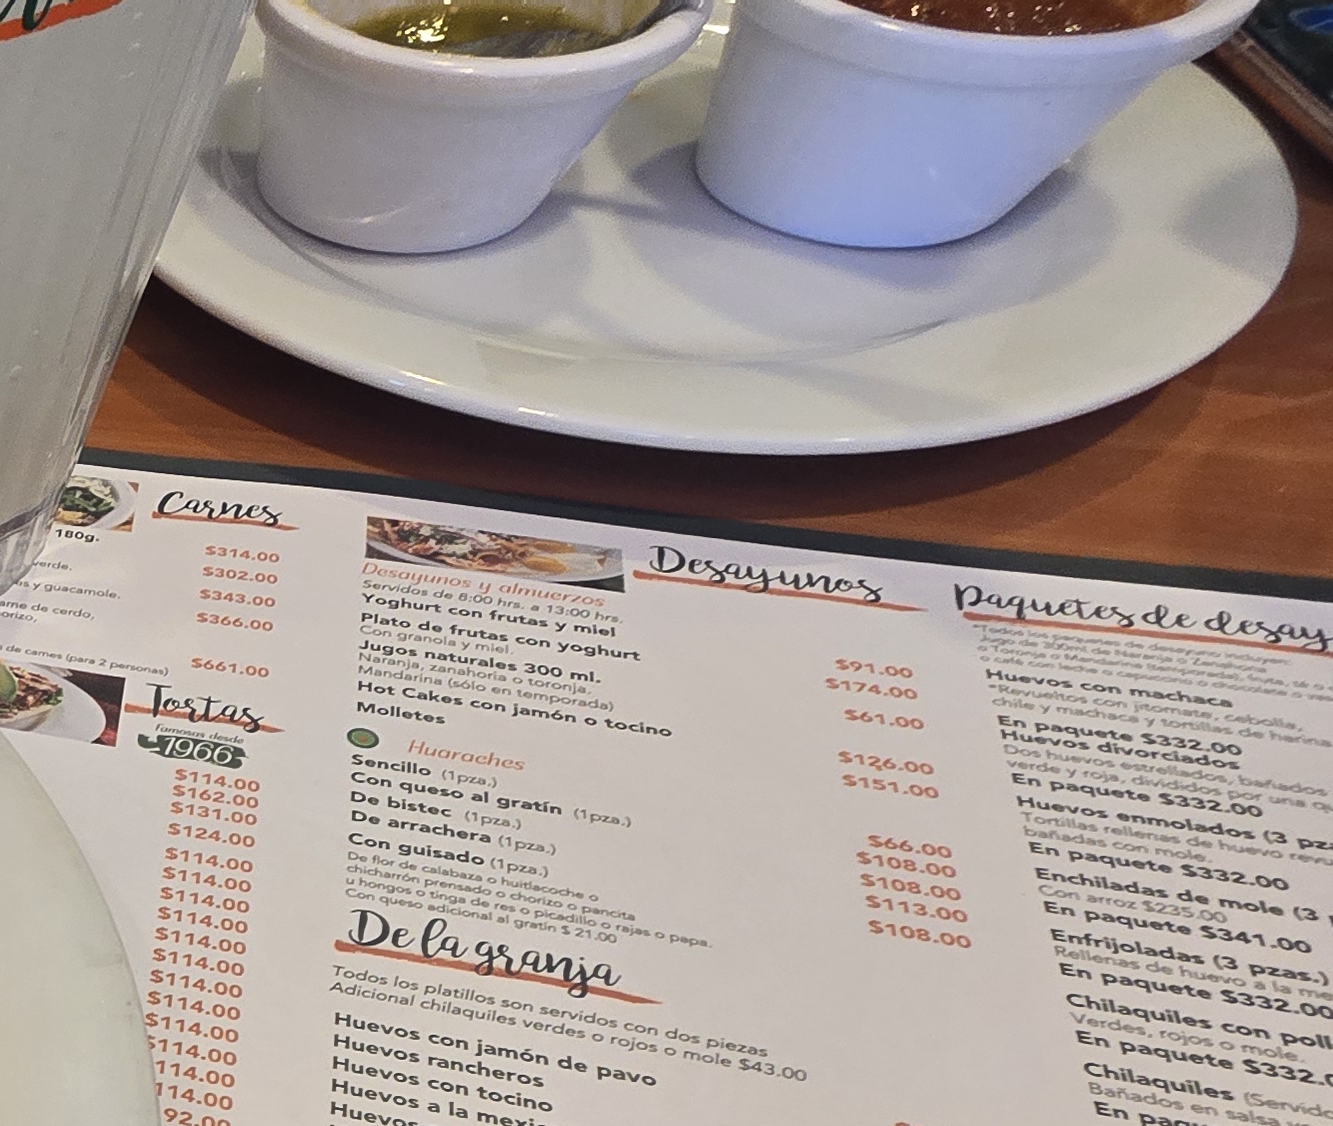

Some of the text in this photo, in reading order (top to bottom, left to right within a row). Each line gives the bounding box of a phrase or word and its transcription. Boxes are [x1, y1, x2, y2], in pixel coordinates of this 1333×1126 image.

[157, 490, 283, 527] Carnes
[203, 544, 281, 564] $314.00
[201, 564, 279, 585] $302.00
[648, 544, 884, 604] Desayunos
[198, 587, 276, 608] $343.00
[953, 583, 1137, 628] Paquetes
[1141, 604, 1198, 630] de
[195, 610, 274, 633] $366.00
[360, 591, 617, 639] Yoghurt con frutas y miel
[190, 656, 270, 679] $661.00
[833, 657, 914, 679] $91.00
[357, 663, 615, 713] Mandarina (sólo en temporada)
[823, 676, 919, 701] $174.00
[984, 667, 1235, 709] Huevos con machaca
[145, 682, 265, 734] Tortas
[355, 700, 446, 725] Molletes
[356, 679, 673, 738] Hot Cakes con jamón o tocino
[842, 707, 925, 731] $61.00
[162, 736, 234, 765] 1966
[407, 738, 526, 771] Huaraches
[836, 749, 935, 776] $126.00
[173, 767, 261, 793] $114.00
[840, 772, 940, 800] $151.00
[171, 783, 260, 810] $162.00
[168, 799, 258, 827] $131.00
[166, 821, 256, 849] $124.00
[350, 808, 557, 857] De arrachera (1pza.)
[866, 833, 953, 859] $66.00
[164, 846, 253, 874] $114.00
[854, 849, 958, 879] $108.00
[864, 893, 969, 924] $113.00
[154, 927, 247, 956] $114.00
[1042, 899, 1313, 955] En paquete $341.00
[347, 908, 622, 999] De la granja
[1048, 927, 1329, 987] Enfrijoladas (3 pzas.)
[331, 963, 769, 1058] Todos los platillos son servidos con dos piezas
[144, 1012, 240, 1044] $114.00
[332, 1032, 545, 1088] Huevos rancheros
[330, 1077, 420, 1109] Huevos
[426, 1101, 441, 1114] a
[447, 1100, 469, 1120] la
